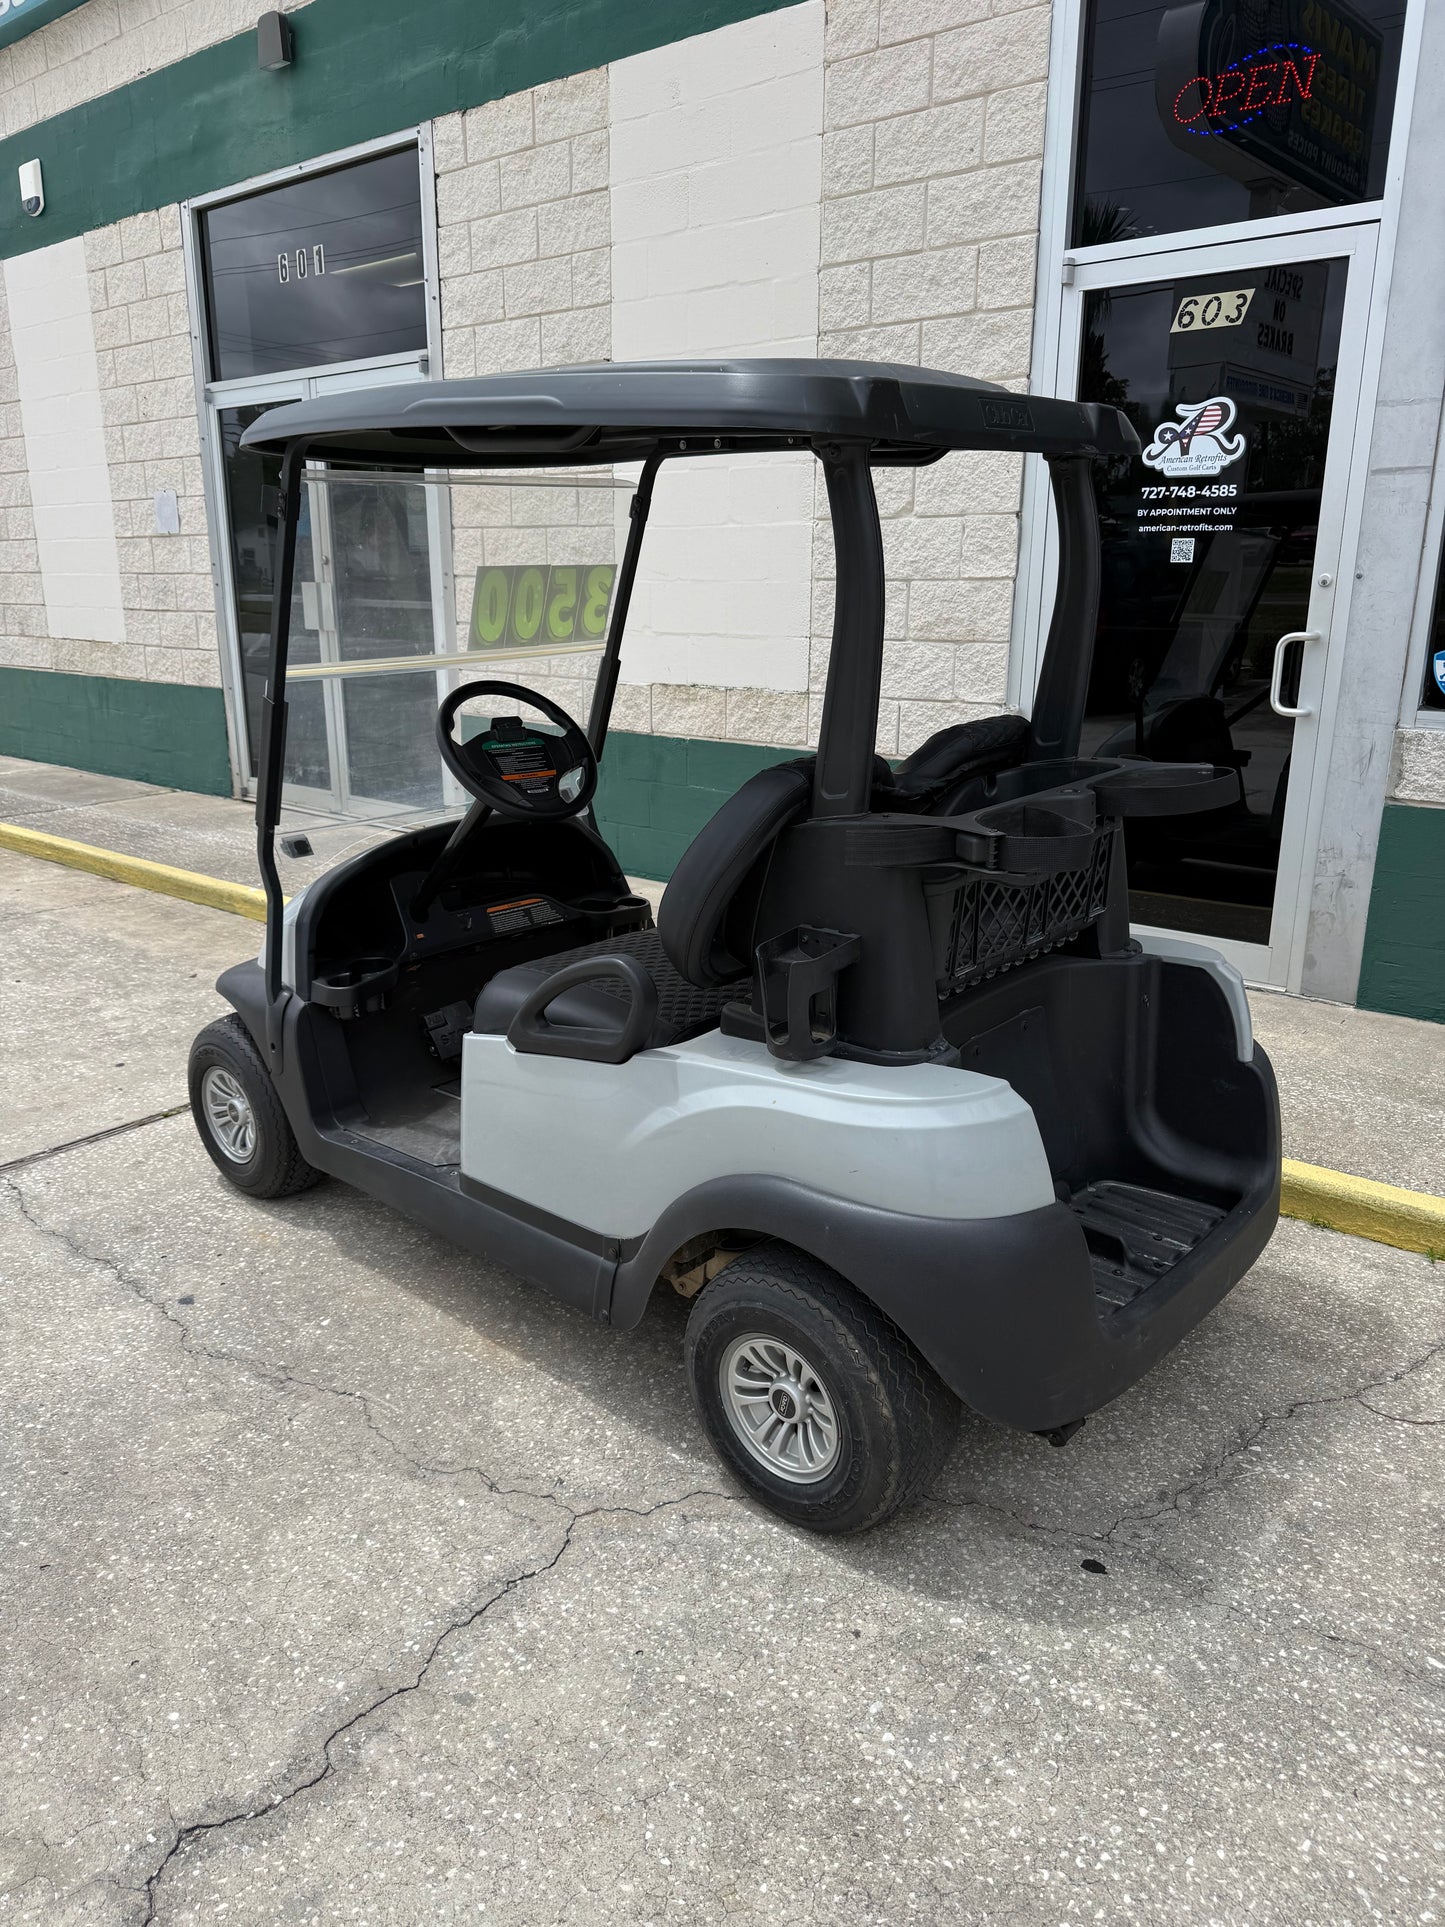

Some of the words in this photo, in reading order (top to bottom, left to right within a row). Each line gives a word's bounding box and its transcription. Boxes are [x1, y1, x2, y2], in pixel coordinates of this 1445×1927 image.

[1174, 53, 1322, 124] OPEN
[280, 246, 323, 282] 601
[1177, 293, 1248, 329] 603
[1159, 455, 1194, 465] American
[1195, 452, 1227, 465] Retrofits
[1188, 464, 1201, 472] Golf
[1141, 484, 1238, 499] 727-748-4585
[1137, 509, 1149, 517] BY
[1149, 507, 1212, 517] APPOINTMENT
[1213, 507, 1238, 515] ONLY
[1138, 523, 1233, 532] american-retrofits.com
